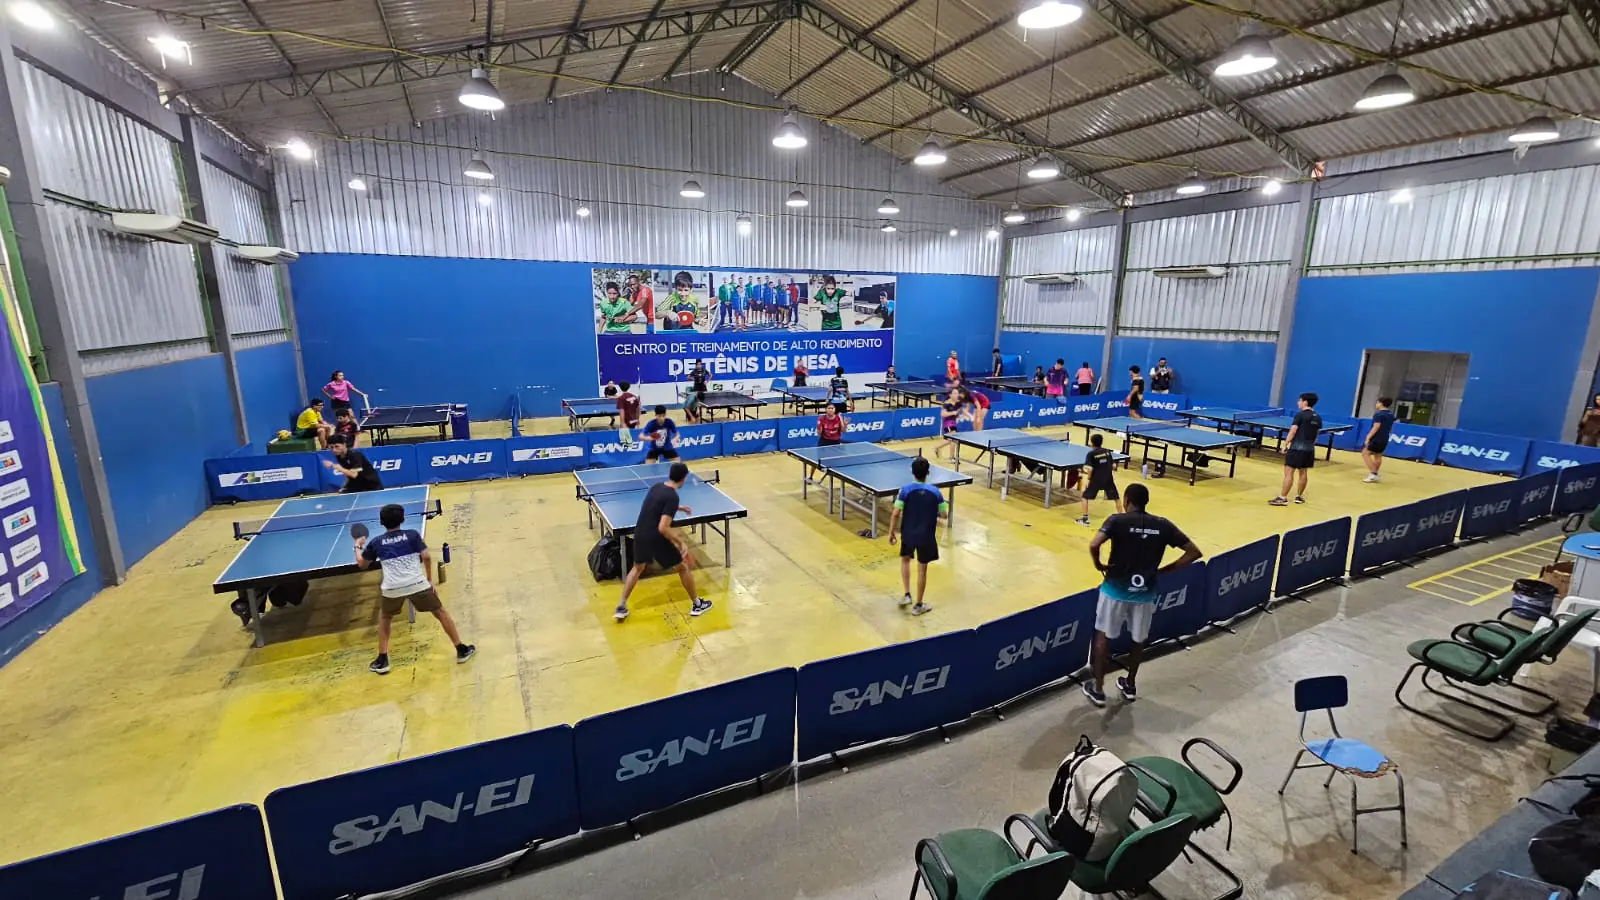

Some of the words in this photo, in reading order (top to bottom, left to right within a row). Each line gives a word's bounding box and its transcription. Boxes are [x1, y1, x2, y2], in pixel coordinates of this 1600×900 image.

[614, 343, 668, 355] CENTRO
[670, 342, 687, 353] DE
[690, 340, 770, 353] TREINAMENTO
[773, 341, 787, 351] DE
[790, 340, 817, 350] ALTO
[820, 338, 883, 349] RENDIMENTO
[668, 359, 697, 376] DE
[701, 353, 759, 374] TÊNIS
[764, 355, 788, 372] DE
[847, 421, 885, 432] SAN-EI
[901, 416, 935, 427] SAN-EI
[733, 429, 773, 441] SAN-EI
[788, 427, 818, 439] SAN-
[431, 451, 492, 467] SAN-EI
[1441, 443, 1510, 461] SAN-EI
[1292, 539, 1338, 567] SAN-EI
[1218, 560, 1268, 596] SAN-EI
[995, 620, 1079, 670] SAN-EI
[830, 665, 950, 716] SAN-EI
[616, 714, 766, 781] SAN-EI
[328, 774, 535, 855] SAN-EI
